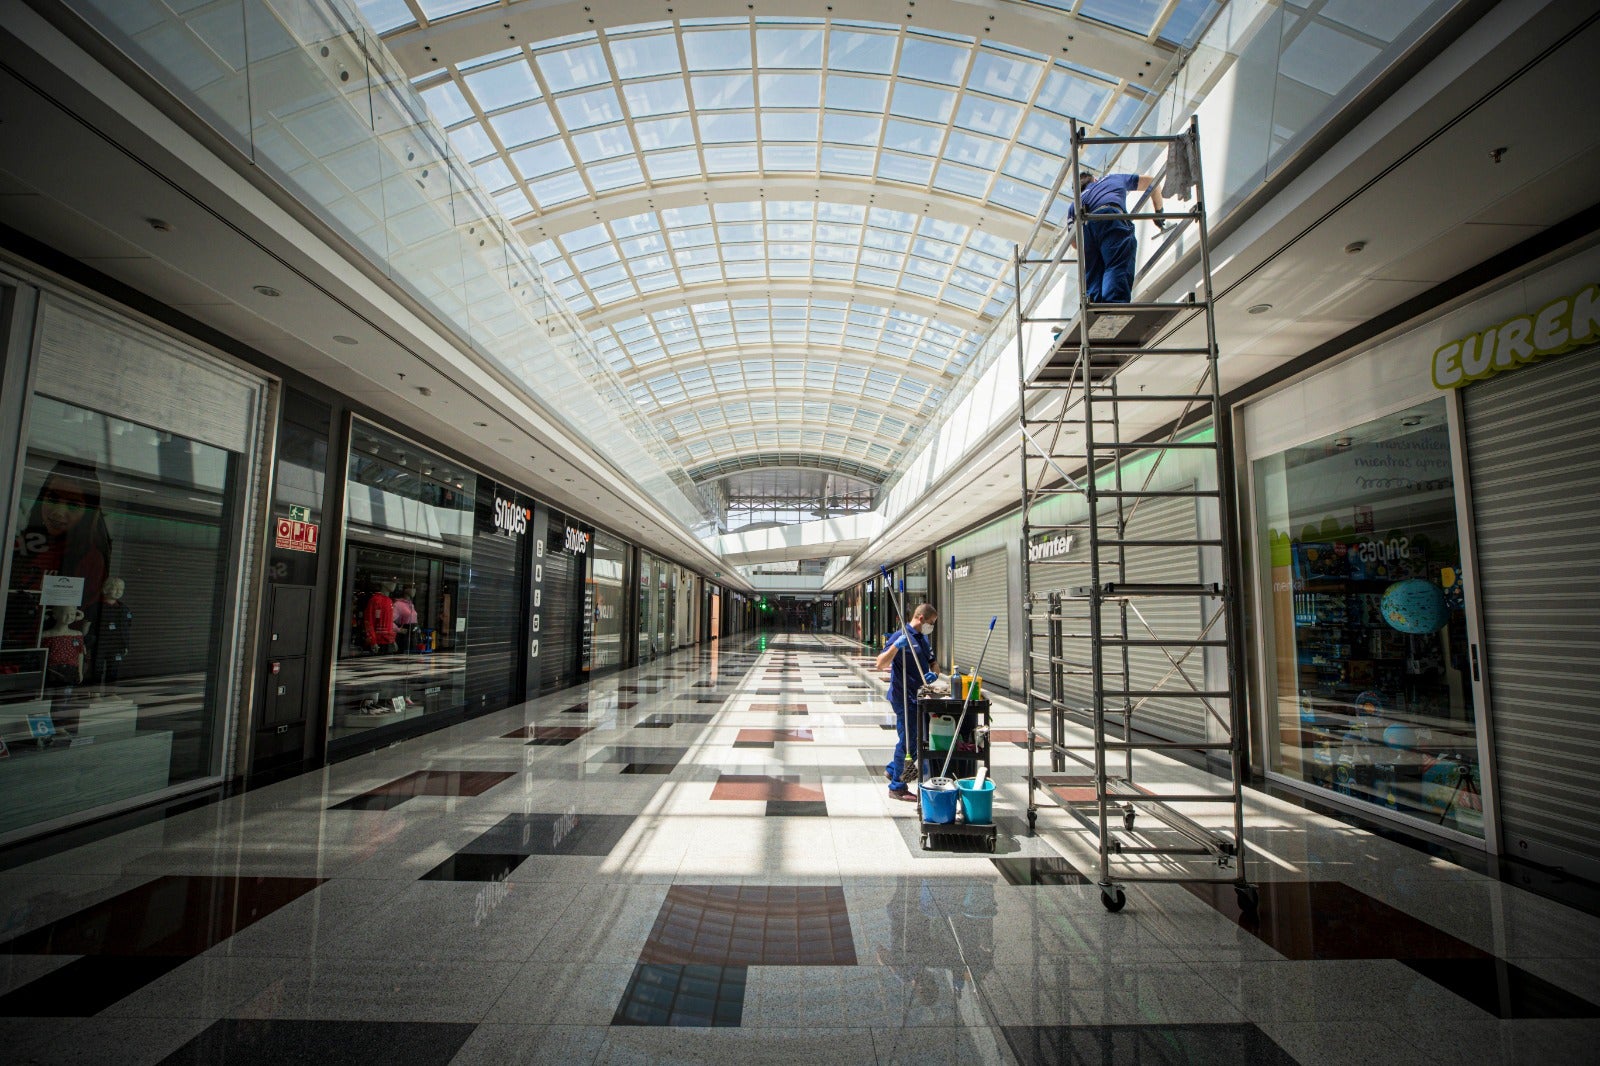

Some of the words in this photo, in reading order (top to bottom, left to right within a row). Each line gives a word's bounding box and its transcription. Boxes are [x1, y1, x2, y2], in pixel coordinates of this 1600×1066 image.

[1435, 287, 1600, 385] EUREK
[494, 496, 527, 537] snipes
[565, 525, 587, 556] snipes
[37, 721, 49, 734] 6
